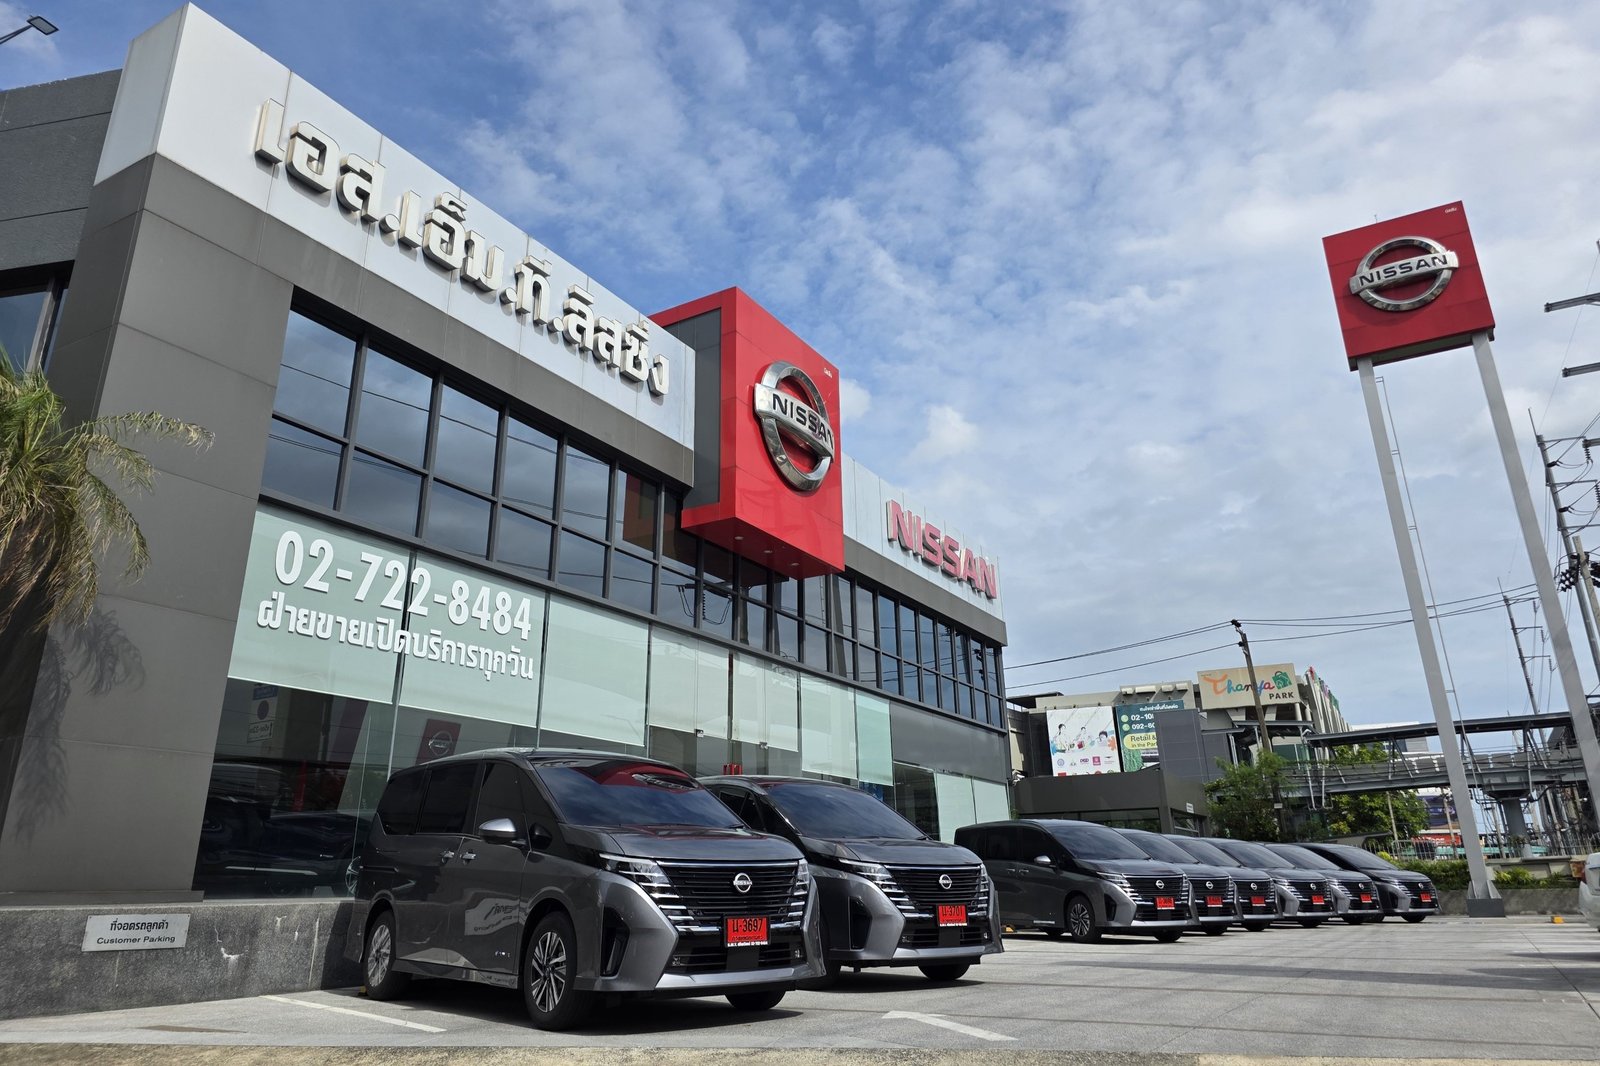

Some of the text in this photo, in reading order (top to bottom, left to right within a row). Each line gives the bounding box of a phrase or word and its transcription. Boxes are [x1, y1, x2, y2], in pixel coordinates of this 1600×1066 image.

[254, 98, 670, 396] เอส.เอ็ม.ที.ลิสซิ่ง
[1359, 254, 1448, 286] NISSAN
[772, 393, 834, 449] NISSAN
[886, 500, 998, 599] NISSAN
[275, 530, 532, 640] 02-722-8484
[257, 591, 534, 681] ฝ่ายขายเปิดบริการทุกวัน
[1269, 691, 1294, 700] PARK
[1130, 734, 1151, 742] Retail
[96, 935, 176, 945] Customer Parking
[110, 918, 169, 933] ที่จอดรถลูกค้า
